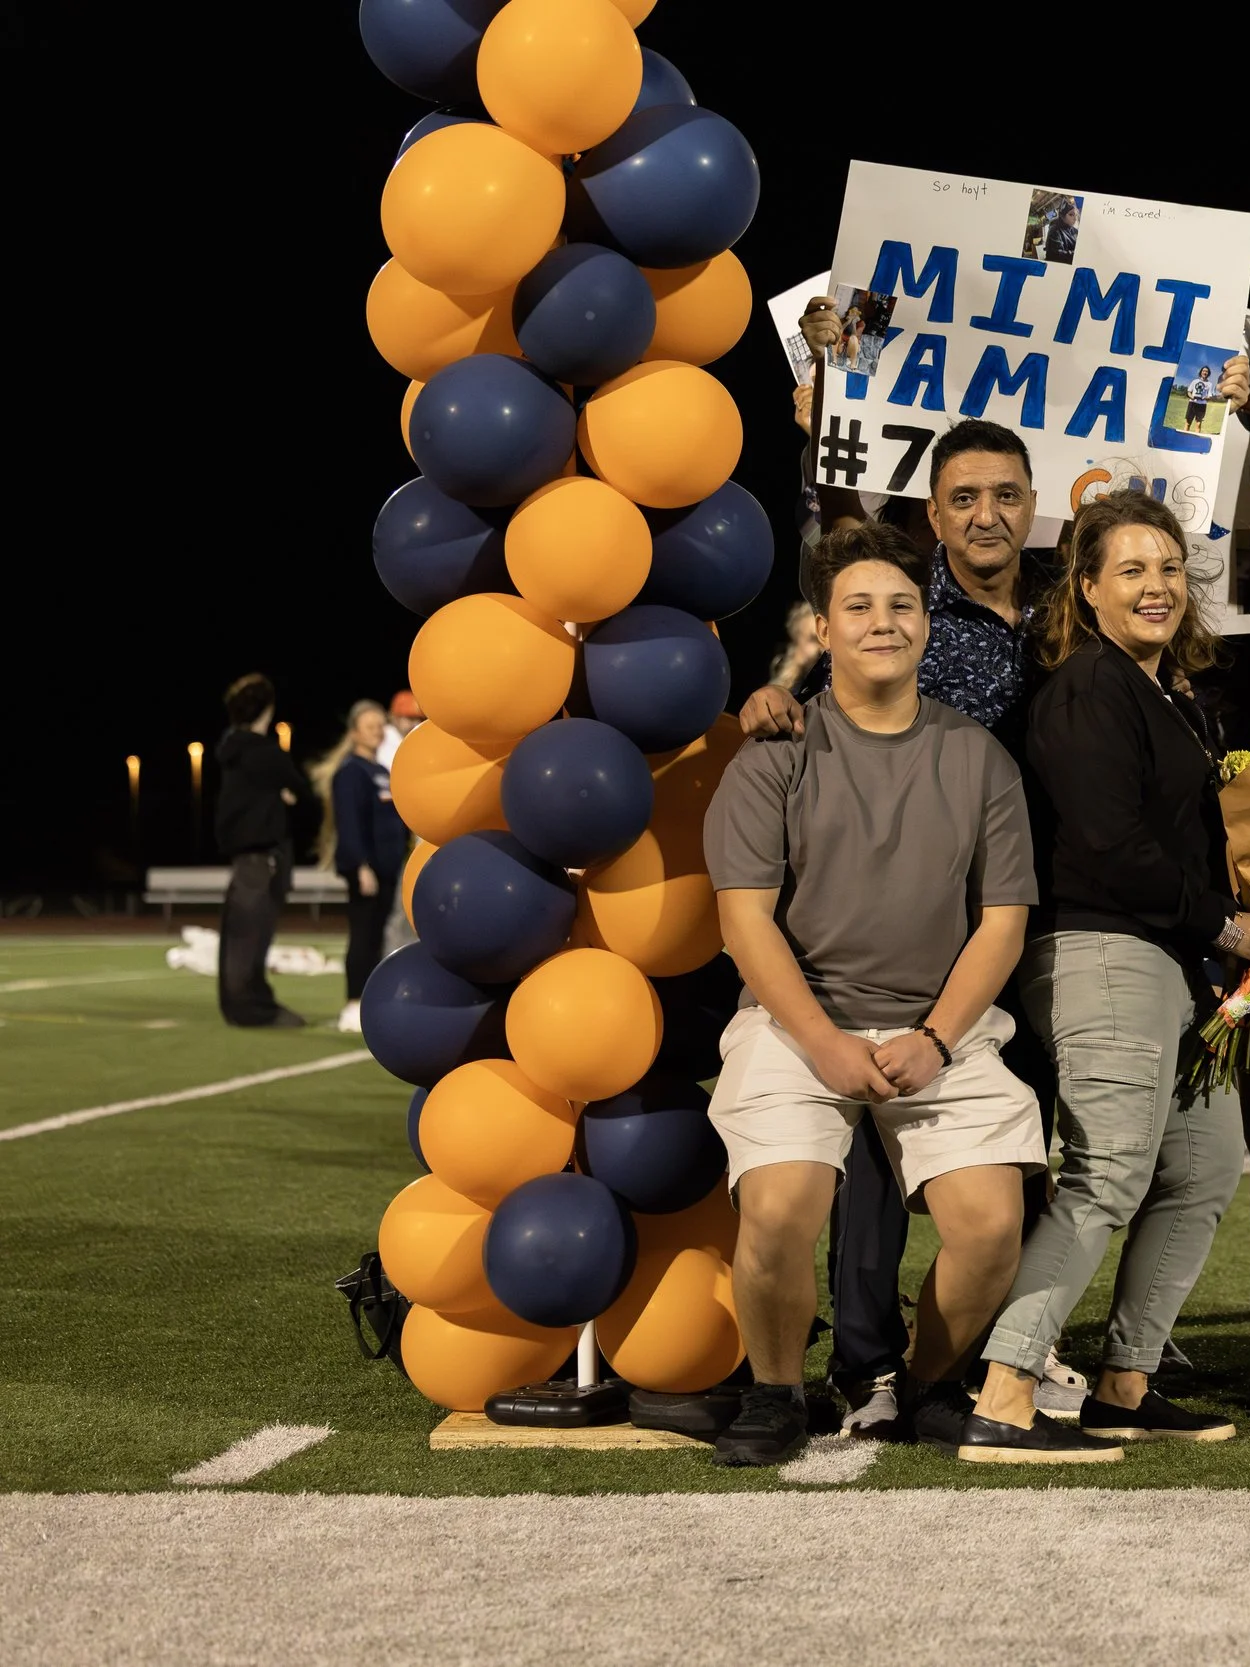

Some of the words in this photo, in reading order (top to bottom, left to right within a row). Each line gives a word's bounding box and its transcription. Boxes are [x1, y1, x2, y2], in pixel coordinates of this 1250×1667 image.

[932, 181, 951, 192] So
[961, 183, 988, 200] hoyt
[871, 239, 1212, 365] MIMI
[820, 415, 936, 493] #7
